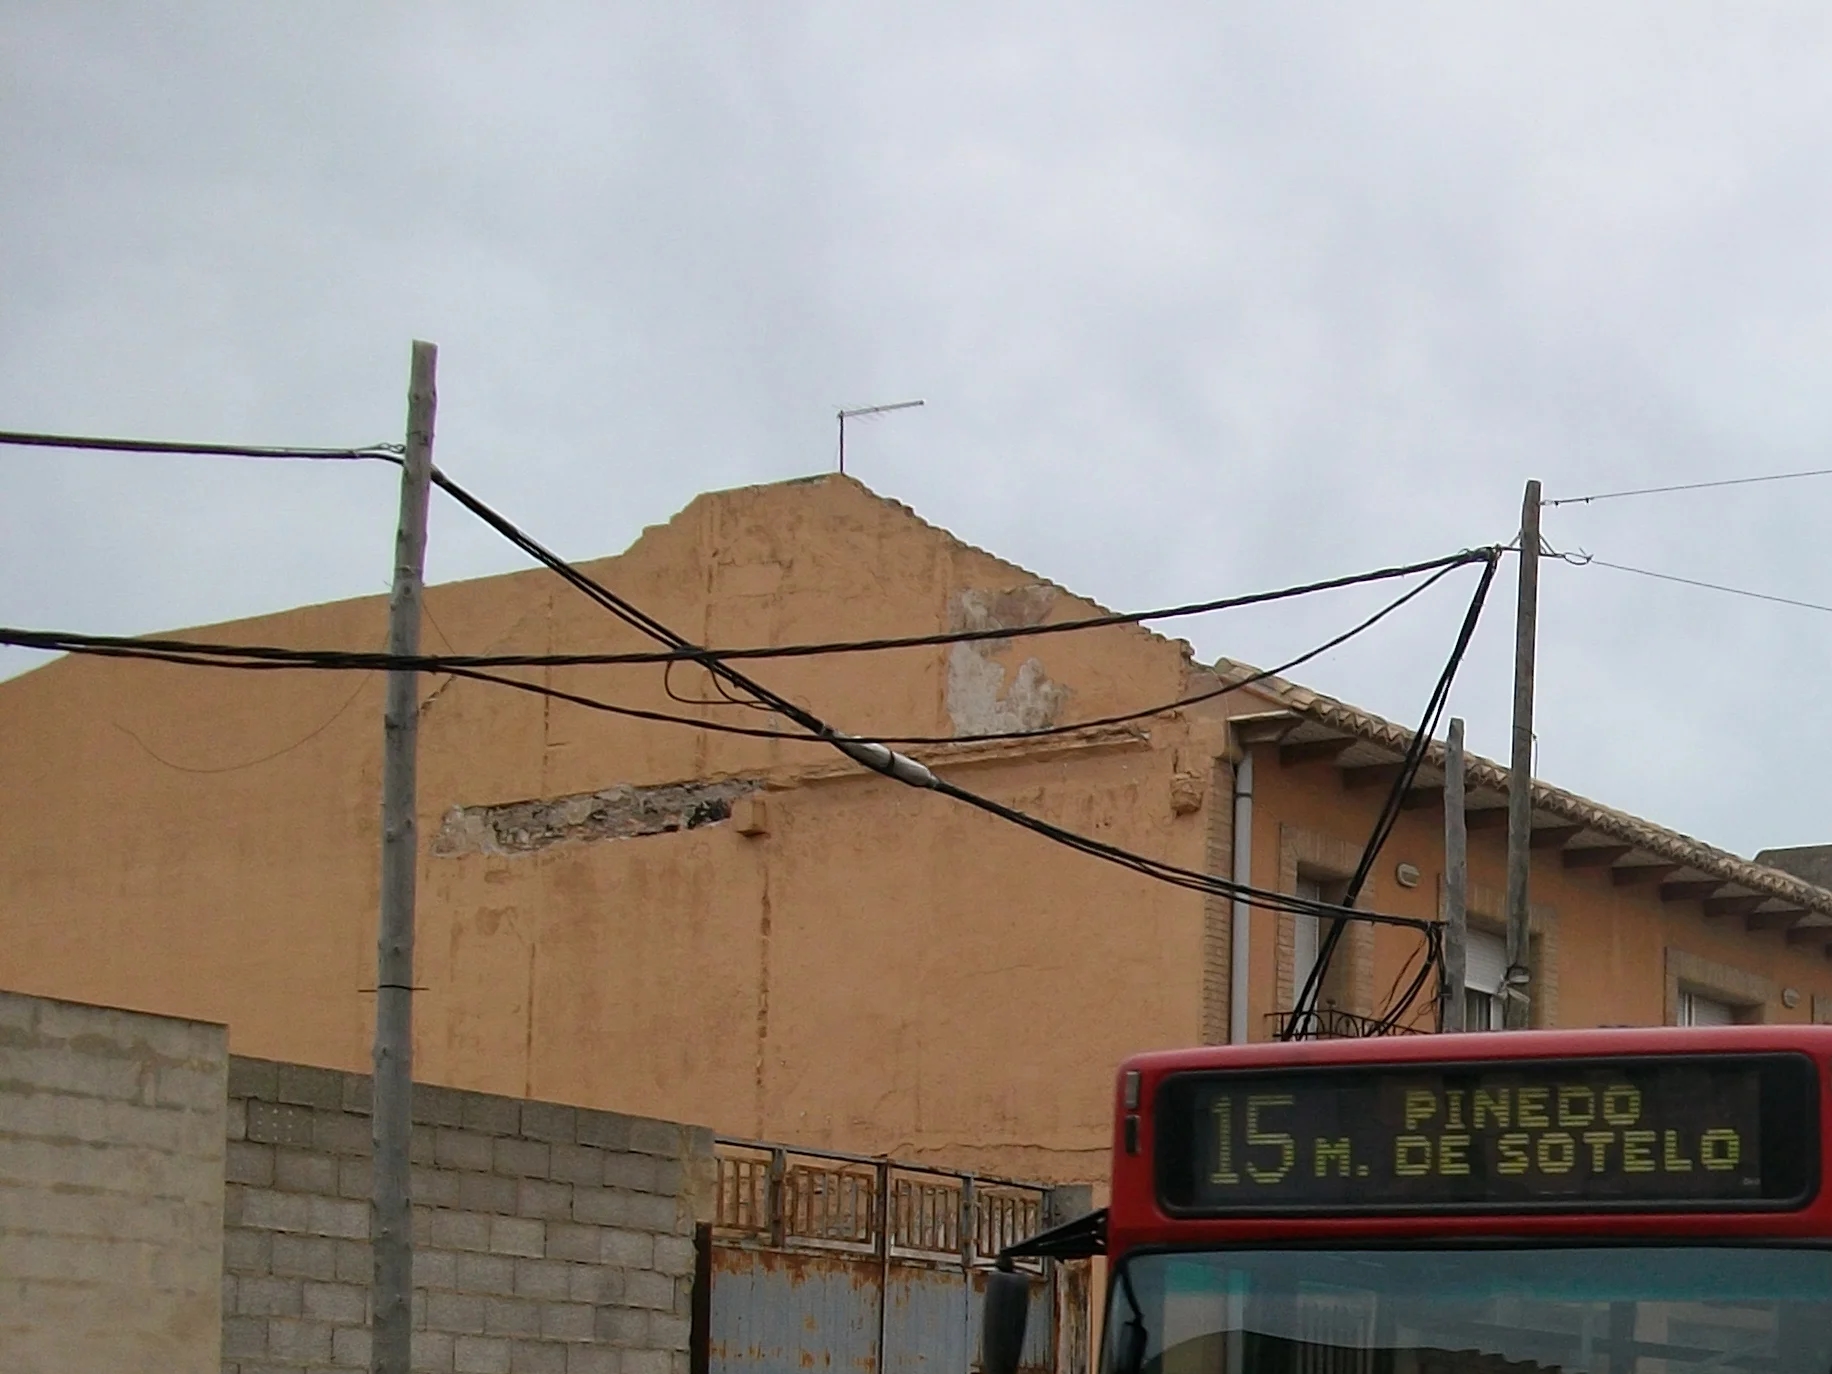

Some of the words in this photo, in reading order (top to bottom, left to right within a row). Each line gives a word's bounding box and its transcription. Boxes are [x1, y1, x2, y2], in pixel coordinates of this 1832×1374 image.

[1404, 1084, 1642, 1131] PINEDO
[1210, 1094, 1296, 1185] 15
[1314, 1136, 1370, 1178] M.
[1395, 1134, 1472, 1176] DE
[1497, 1128, 1741, 1175] SOTELO
